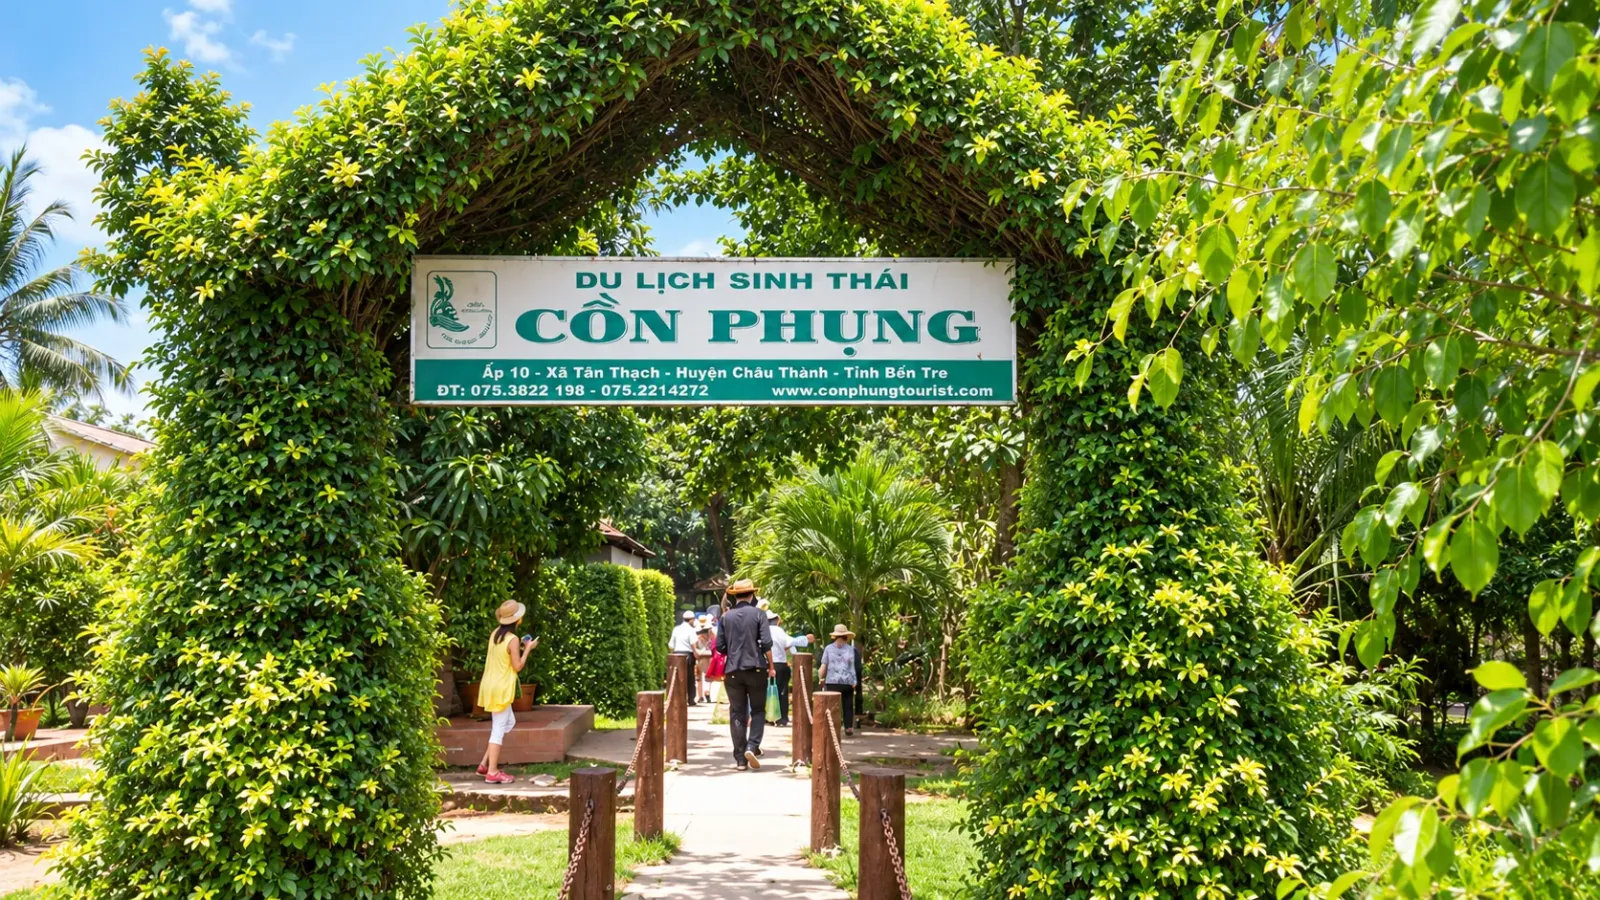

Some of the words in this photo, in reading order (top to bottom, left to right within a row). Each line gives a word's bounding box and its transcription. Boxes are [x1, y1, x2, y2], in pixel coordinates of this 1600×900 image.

[576, 272, 622, 289] DU
[637, 272, 715, 294] LỊCH
[730, 272, 813, 289] SINH
[827, 268, 908, 290] THÁI
[515, 292, 682, 344] CỒN
[708, 309, 981, 357] PHỤNG
[482, 363, 504, 381] Ấp
[511, 366, 530, 379] 10
[546, 366, 568, 379] Xã
[574, 366, 604, 379] Tân
[610, 366, 660, 381] Thạch
[676, 366, 727, 382] Huyện
[733, 366, 773, 379] Châu
[779, 366, 828, 379] Thành
[885, 364, 916, 379] Bến
[922, 367, 948, 379] Tre
[437, 384, 465, 397] ĐT:
[471, 384, 549, 397] 075.3822
[556, 384, 585, 397] 198
[602, 384, 709, 397] 075.2214272
[772, 384, 993, 400] www.conphungtourist.com
